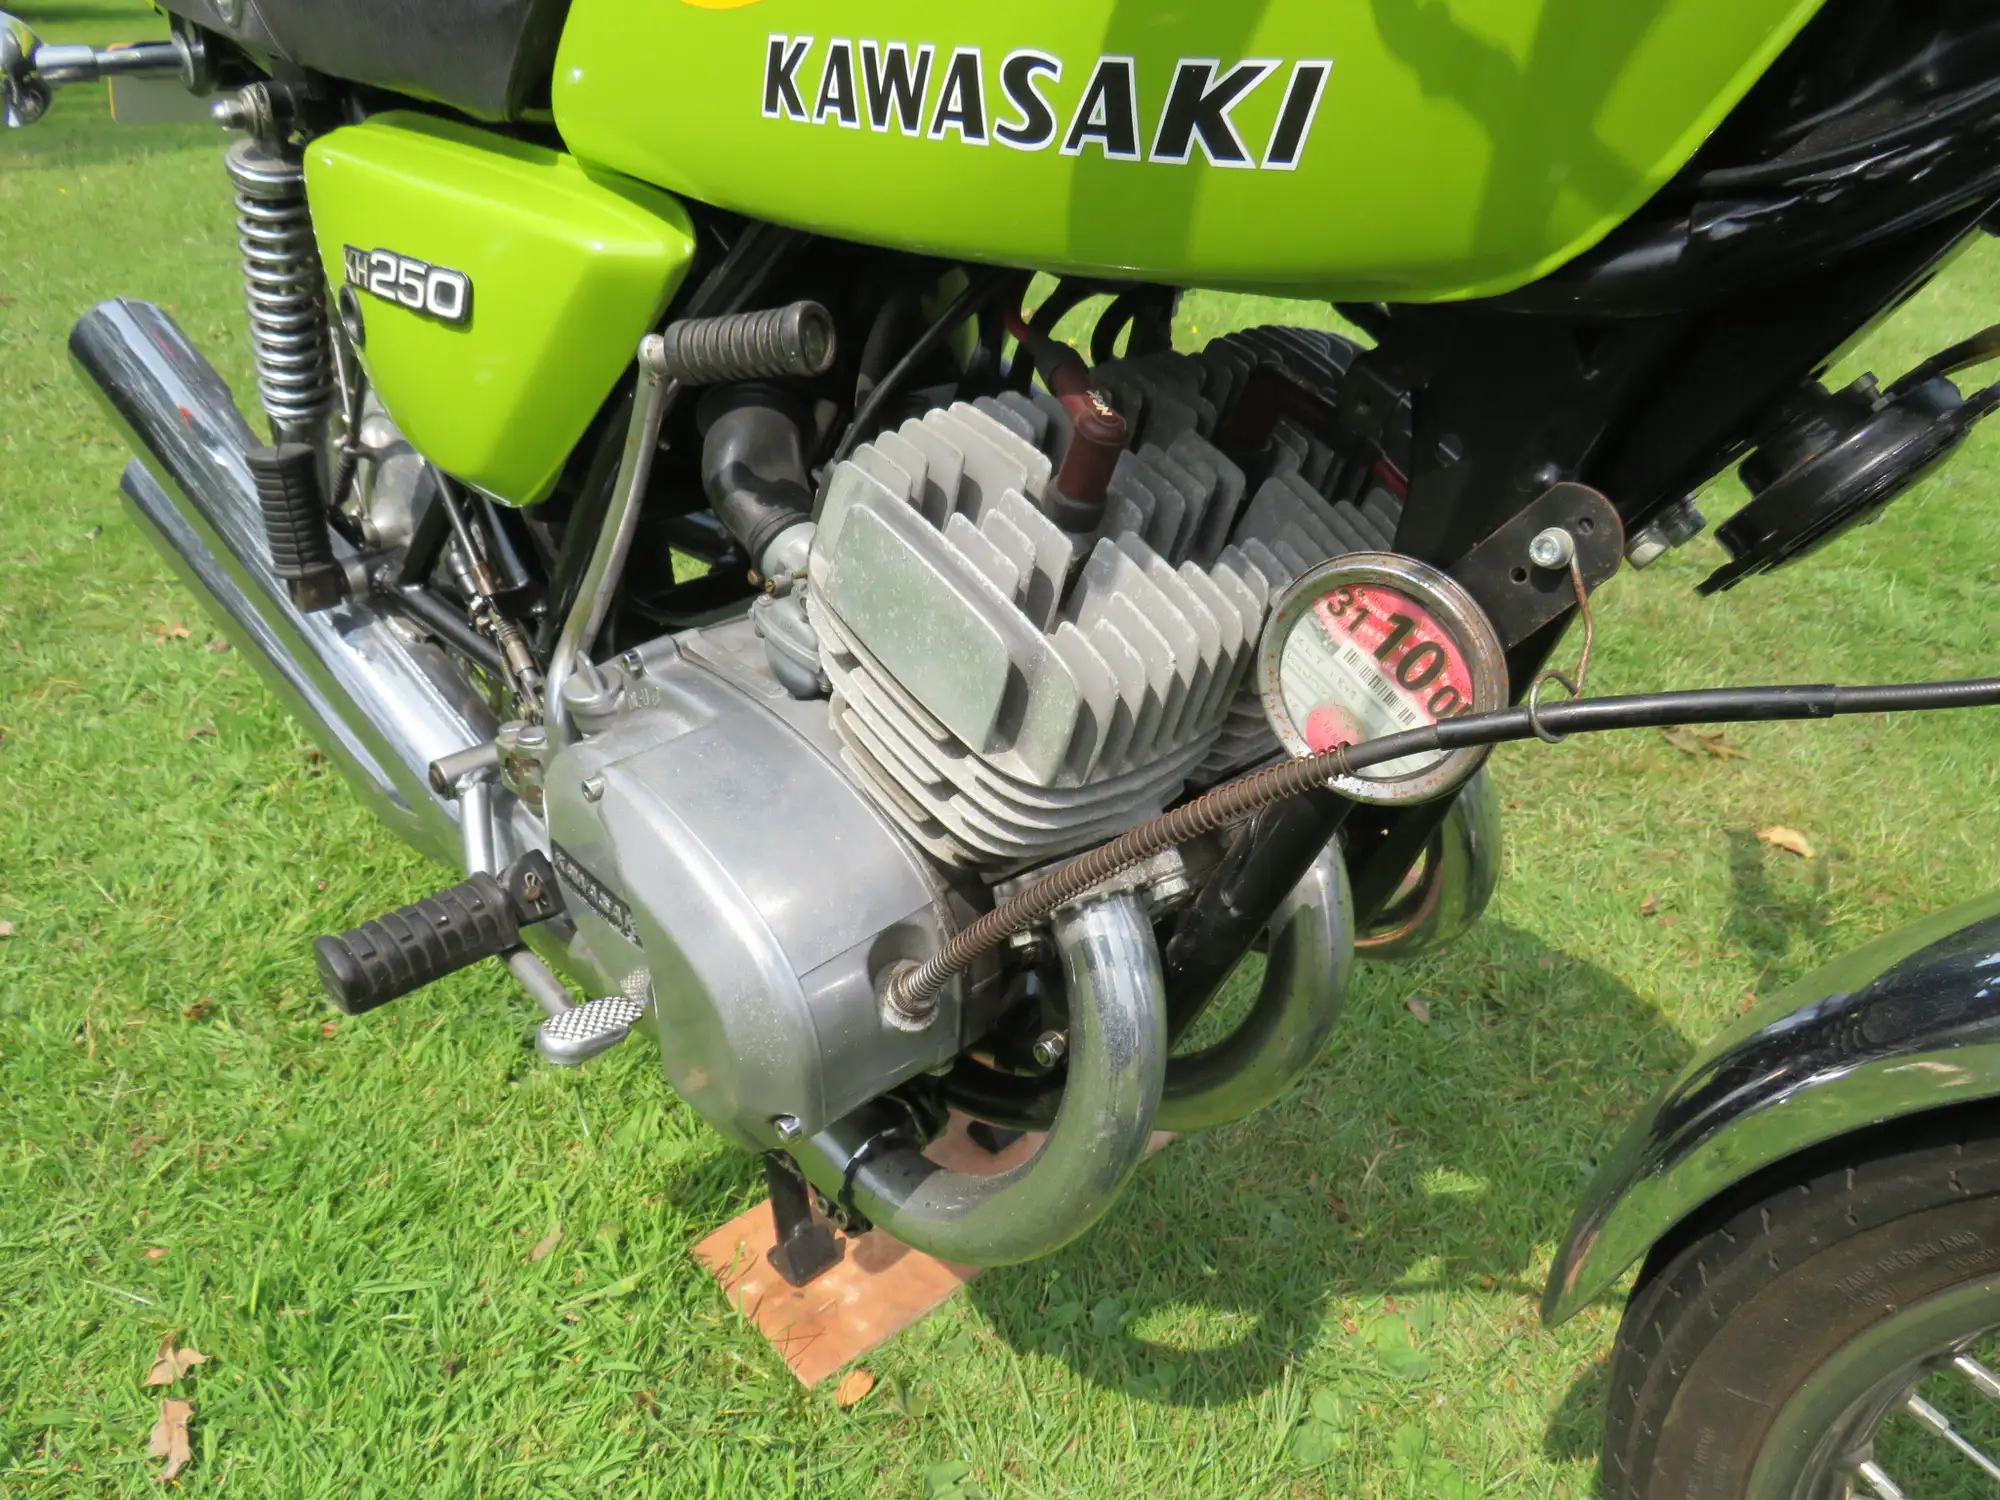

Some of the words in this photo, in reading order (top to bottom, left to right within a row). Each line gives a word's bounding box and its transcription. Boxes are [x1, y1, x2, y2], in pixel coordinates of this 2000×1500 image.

[761, 33, 1334, 171] KAWASAKI
[344, 247, 465, 319] KH250
[1326, 588, 1371, 633] 31
[1373, 613, 1446, 692] 10
